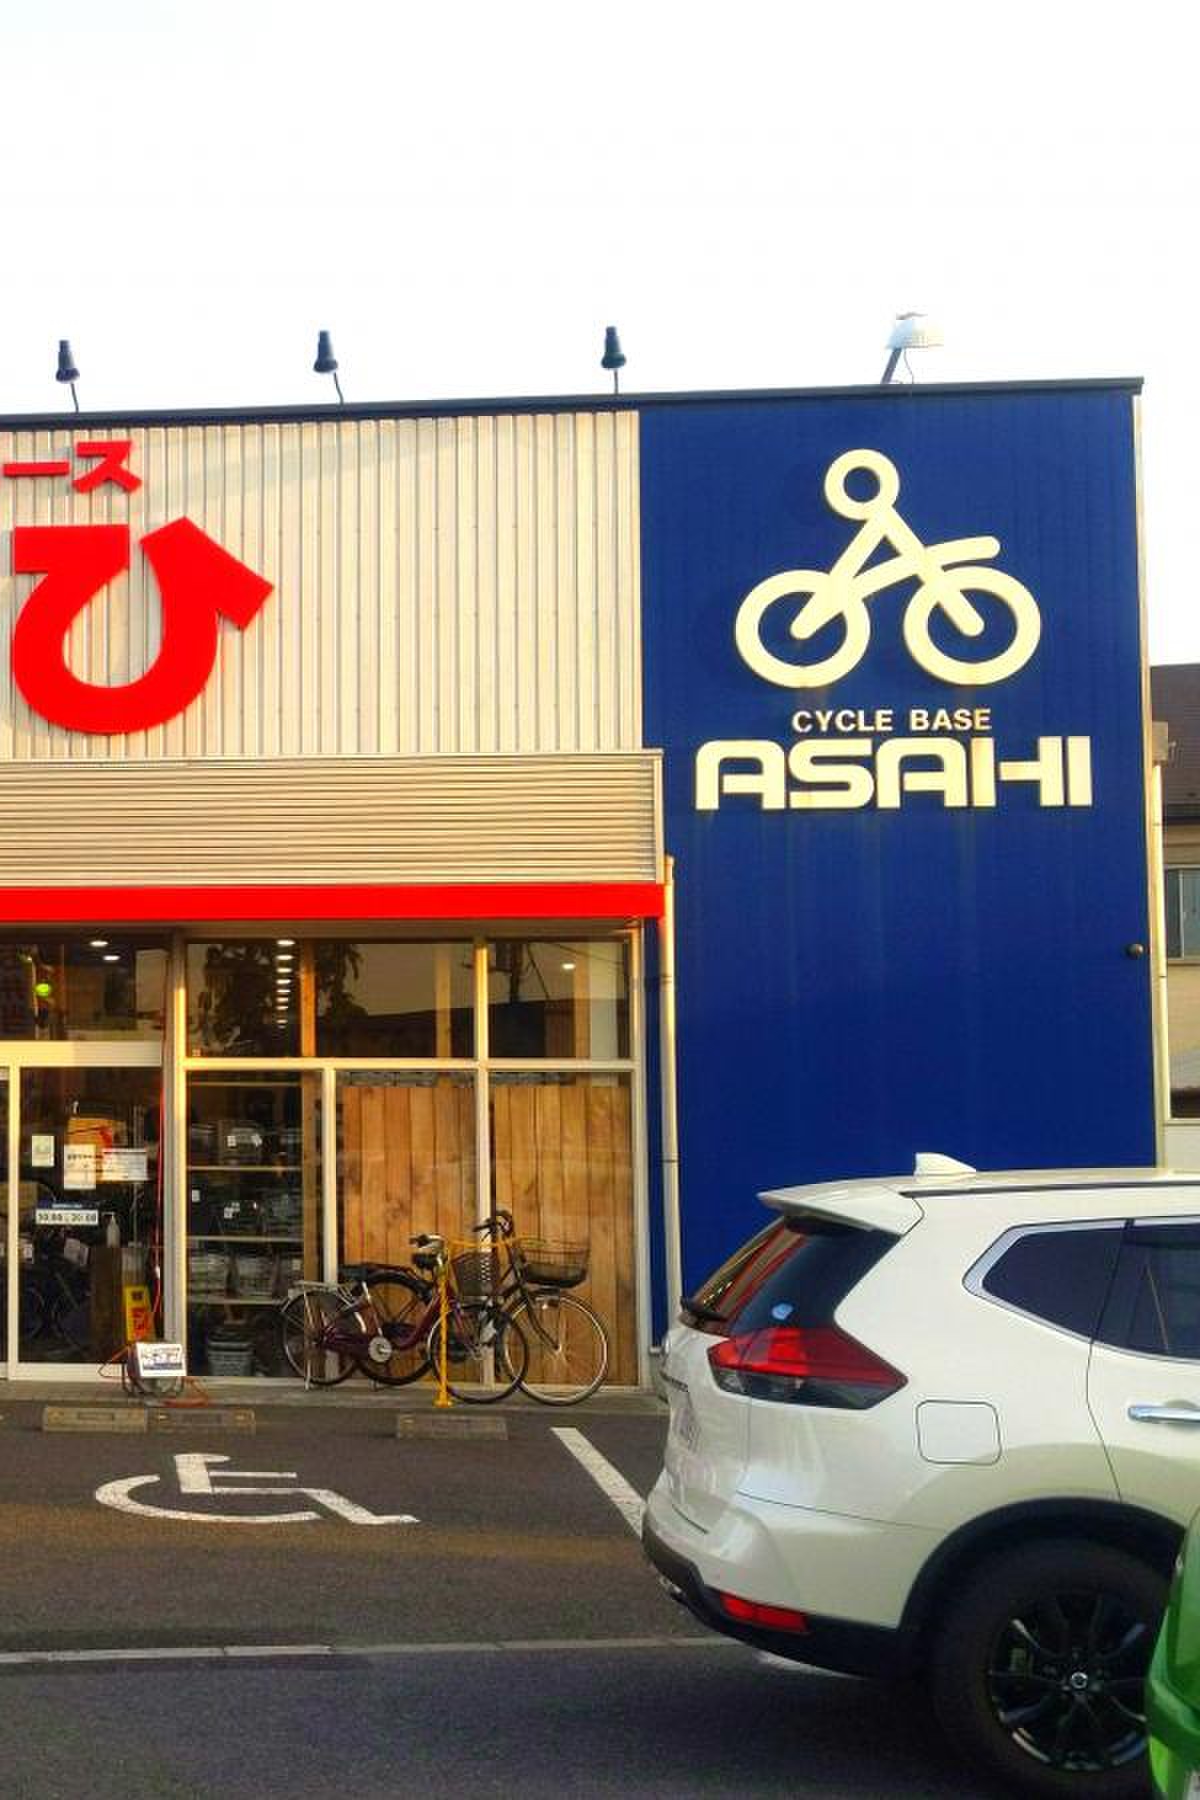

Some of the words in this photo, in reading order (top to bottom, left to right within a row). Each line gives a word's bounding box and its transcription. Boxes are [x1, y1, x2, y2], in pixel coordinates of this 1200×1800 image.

[791, 709, 895, 733] CYCLE
[909, 708, 993, 732] BASE
[695, 735, 1094, 811] ASAHI
